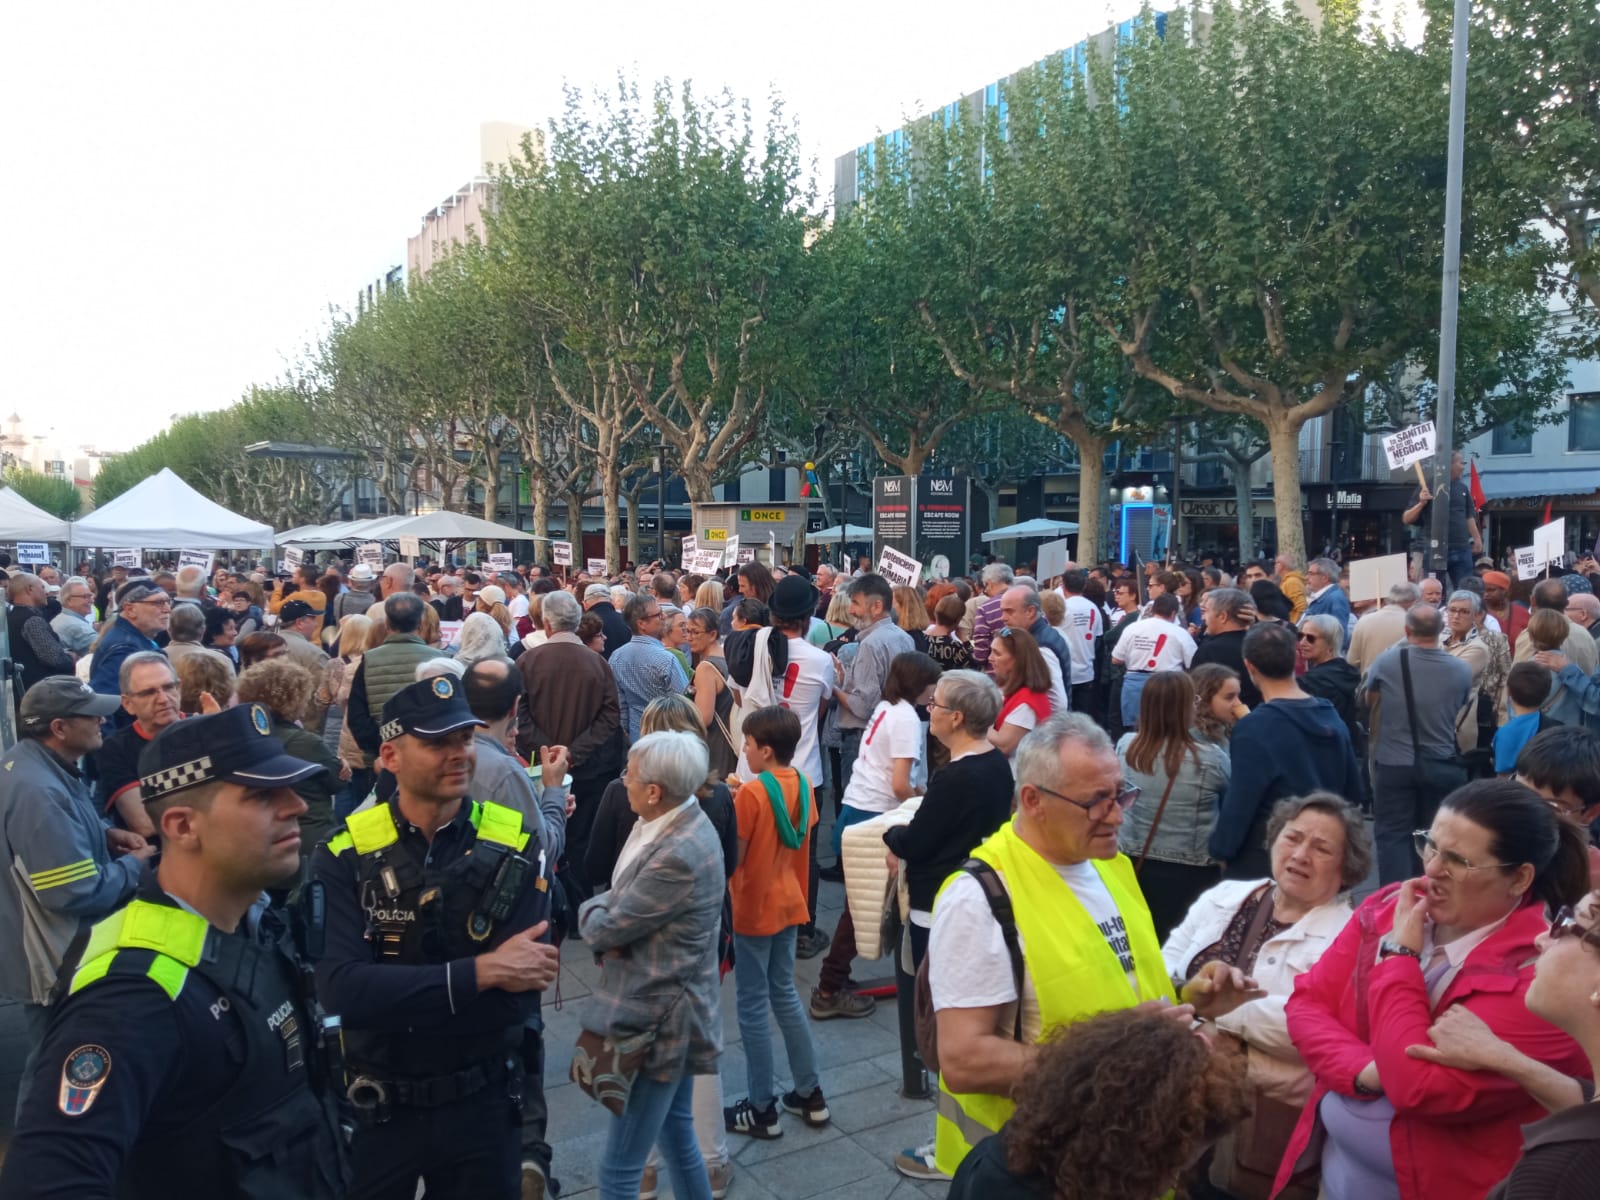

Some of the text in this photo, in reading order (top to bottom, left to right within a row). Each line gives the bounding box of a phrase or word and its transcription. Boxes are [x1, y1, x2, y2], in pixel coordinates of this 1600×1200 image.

[1396, 422, 1432, 443] SANITAT
[1392, 437, 1429, 459] NEGOCI!
[1336, 491, 1362, 504] Mafia
[1181, 500, 1220, 515] Classic
[754, 511, 782, 520] ONCE
[711, 530, 726, 540] ONCE
